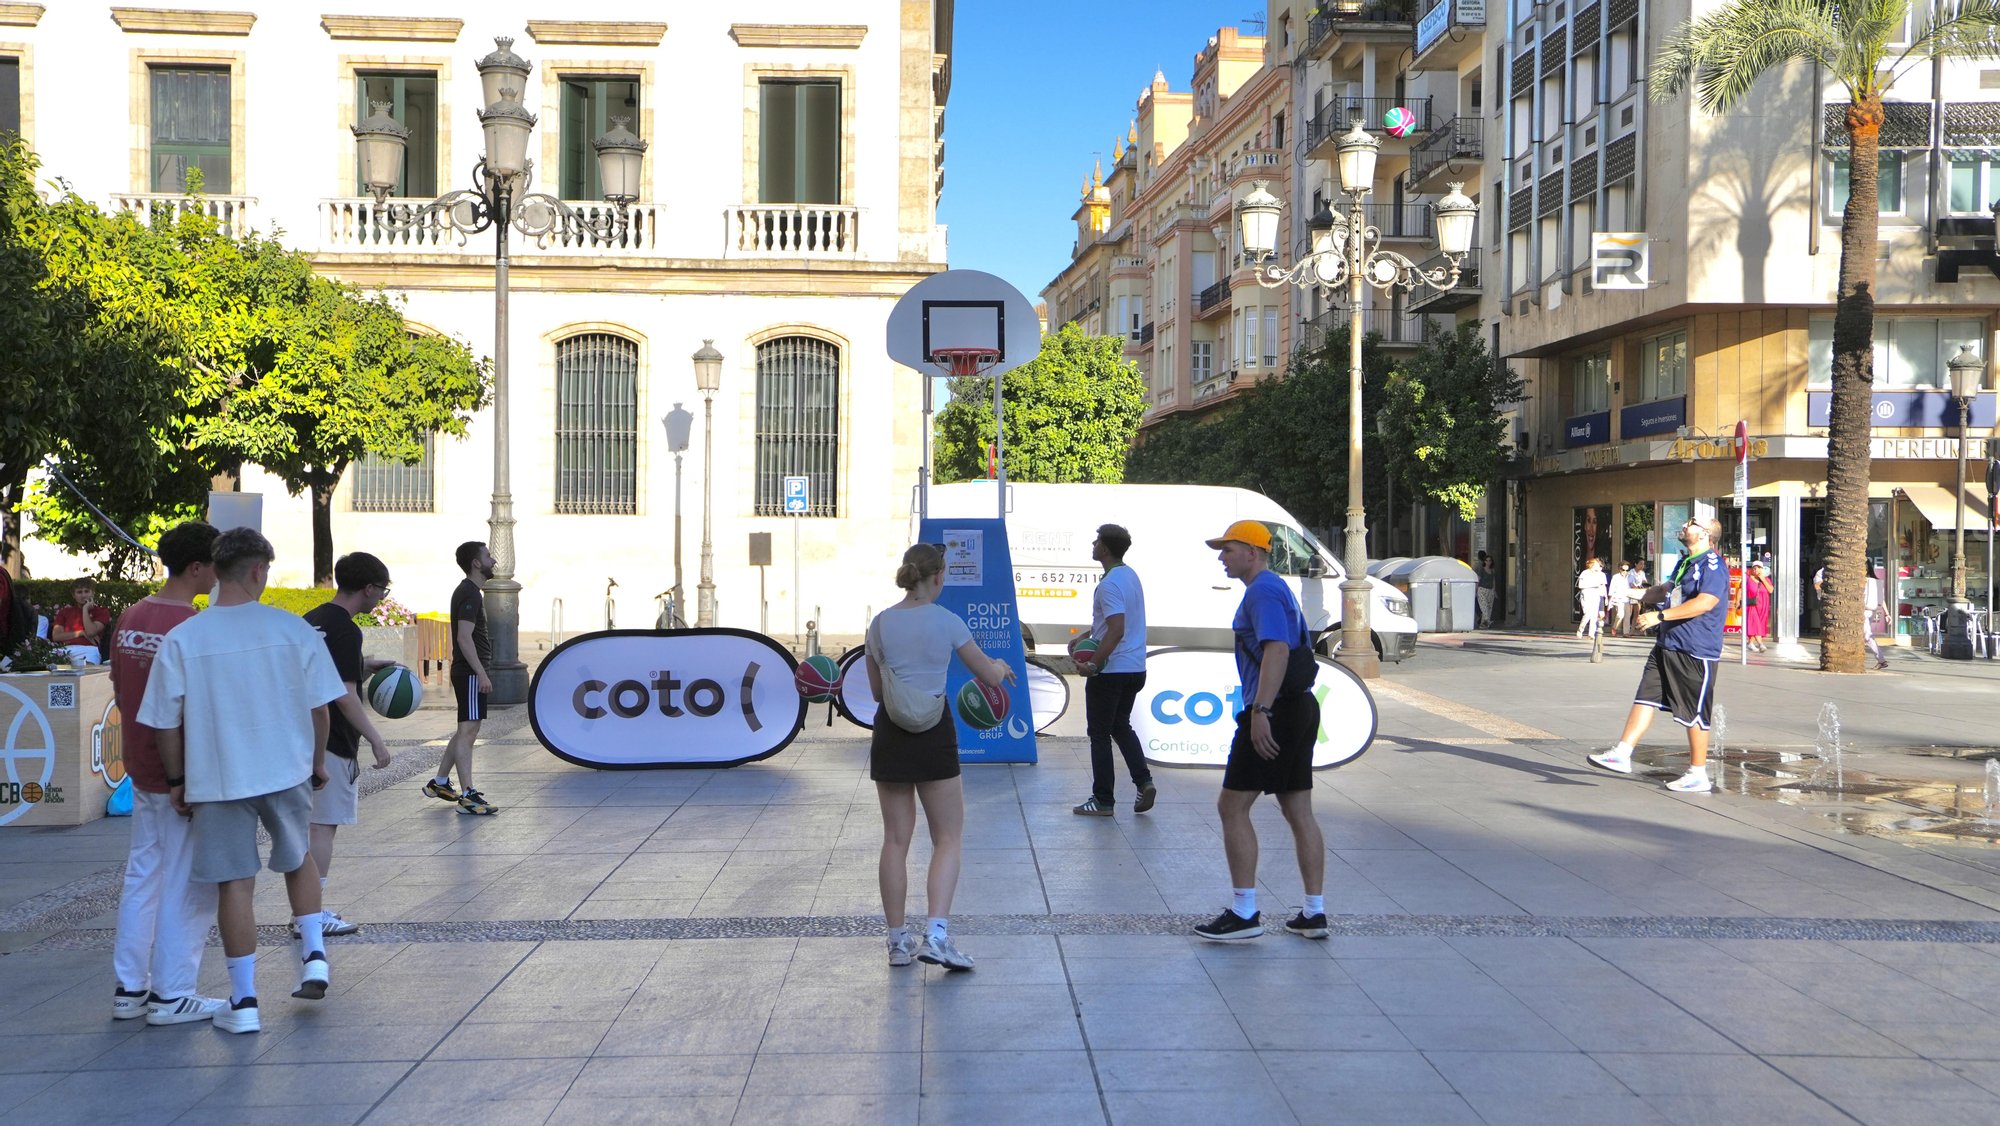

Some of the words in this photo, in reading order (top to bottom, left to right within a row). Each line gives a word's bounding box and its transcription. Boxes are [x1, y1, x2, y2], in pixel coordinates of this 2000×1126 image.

[1641, 416, 1654, 427] Seguros
[1657, 413, 1677, 424] Inversiones
[1571, 426, 1585, 438] Allianz
[790, 482, 801, 495] P
[1022, 531, 1074, 545] RENT
[1041, 573, 1065, 583] 652
[1069, 573, 1088, 583] 721
[967, 603, 1011, 616] PONT
[967, 617, 1011, 630] GRUP
[972, 630, 1011, 640] ORREDURÍA
[979, 640, 1011, 649] SEGUROS
[572, 670, 685, 718] coto
[1150, 685, 1245, 725] cot
[979, 732, 1004, 740] GRUP
